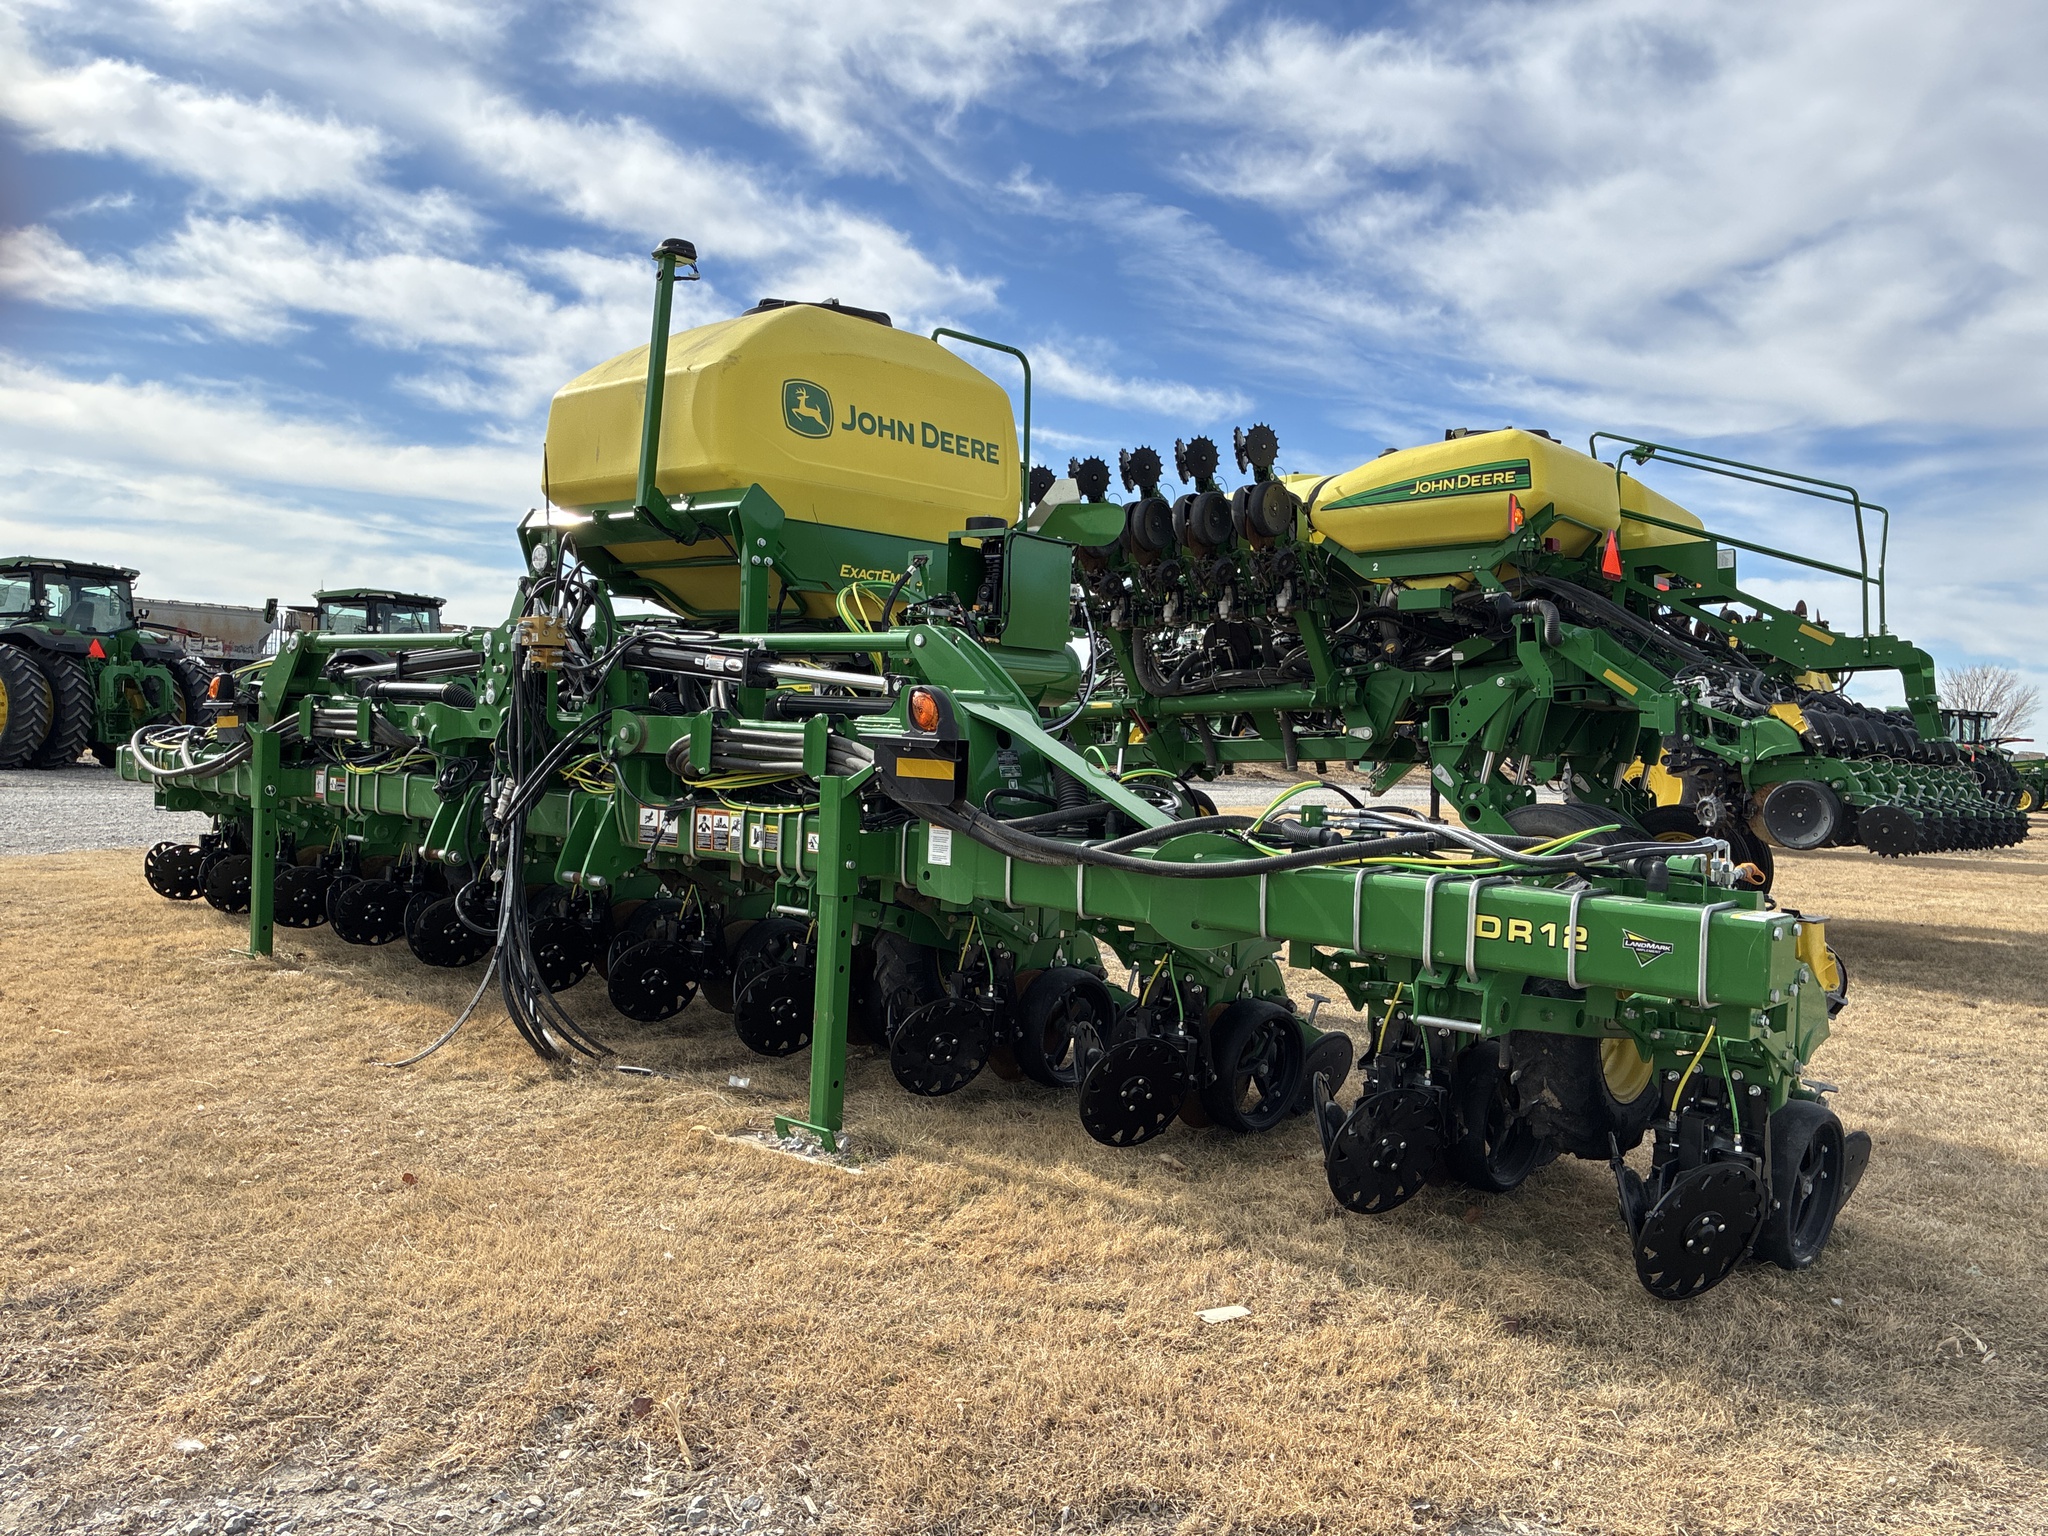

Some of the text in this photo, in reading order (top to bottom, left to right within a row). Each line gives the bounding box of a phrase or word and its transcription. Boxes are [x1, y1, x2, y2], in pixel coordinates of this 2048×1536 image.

[841, 404, 1000, 465] JOHN DEERE
[1409, 470, 1516, 495] JOHN DEERE
[839, 564, 924, 587] EXACTEM
[1372, 562, 1379, 572] 2
[1475, 914, 1588, 951] DR12
[1624, 940, 1671, 952] LANDMARK
